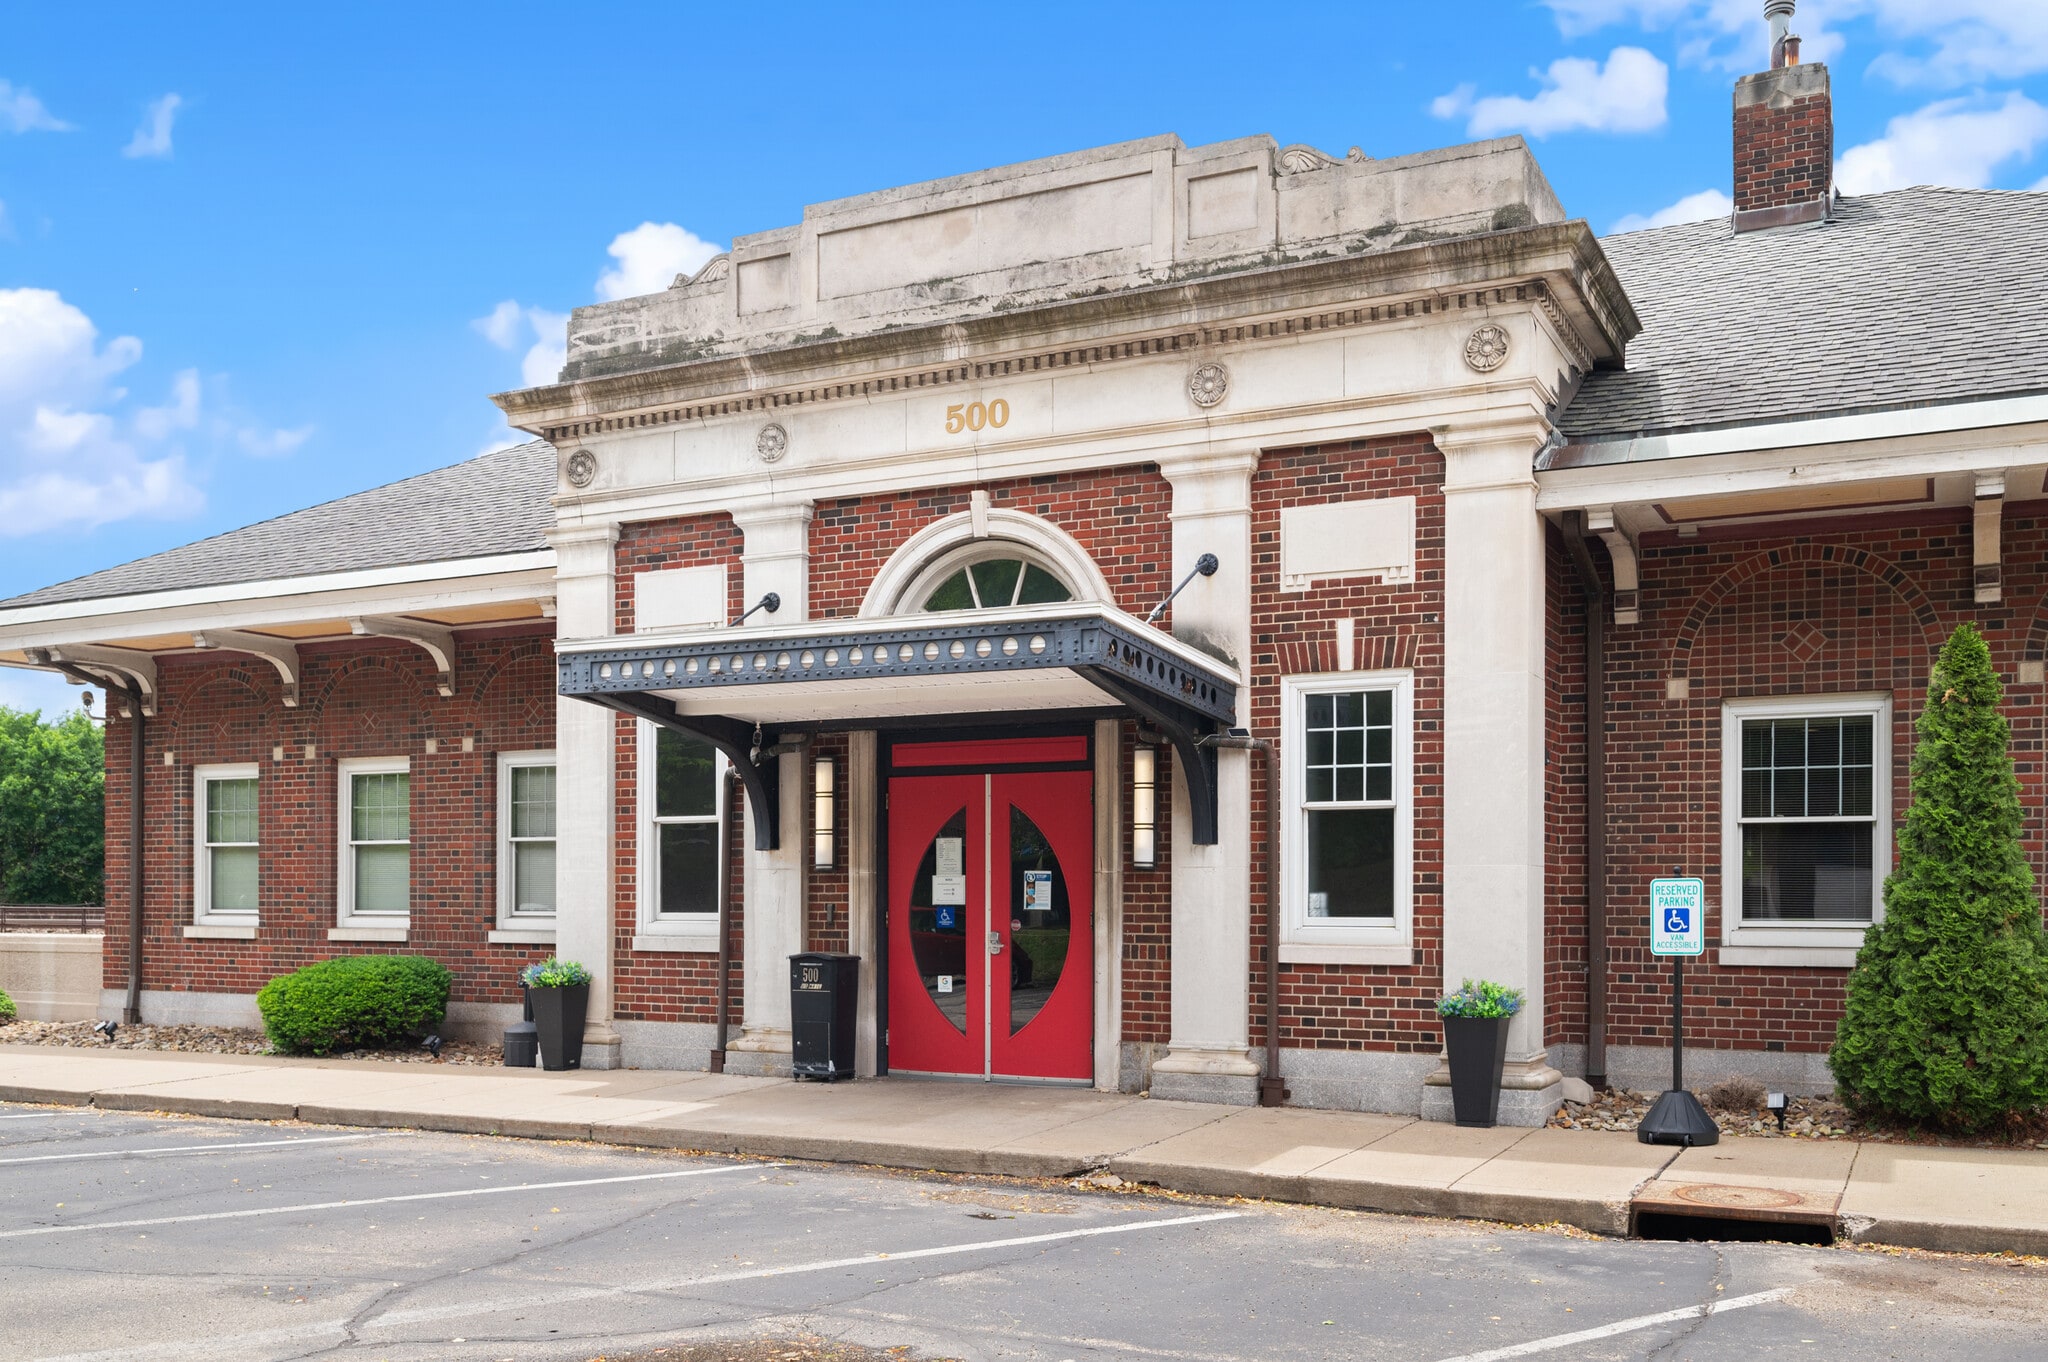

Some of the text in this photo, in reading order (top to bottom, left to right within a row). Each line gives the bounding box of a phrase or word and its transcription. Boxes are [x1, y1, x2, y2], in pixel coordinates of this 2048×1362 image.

[945, 398, 1010, 434] 500
[1655, 885, 1698, 895] RESERVED
[1658, 896, 1695, 906] PARKING
[1656, 941, 1697, 949] ACCESSIBLE
[802, 967, 819, 982] 500
